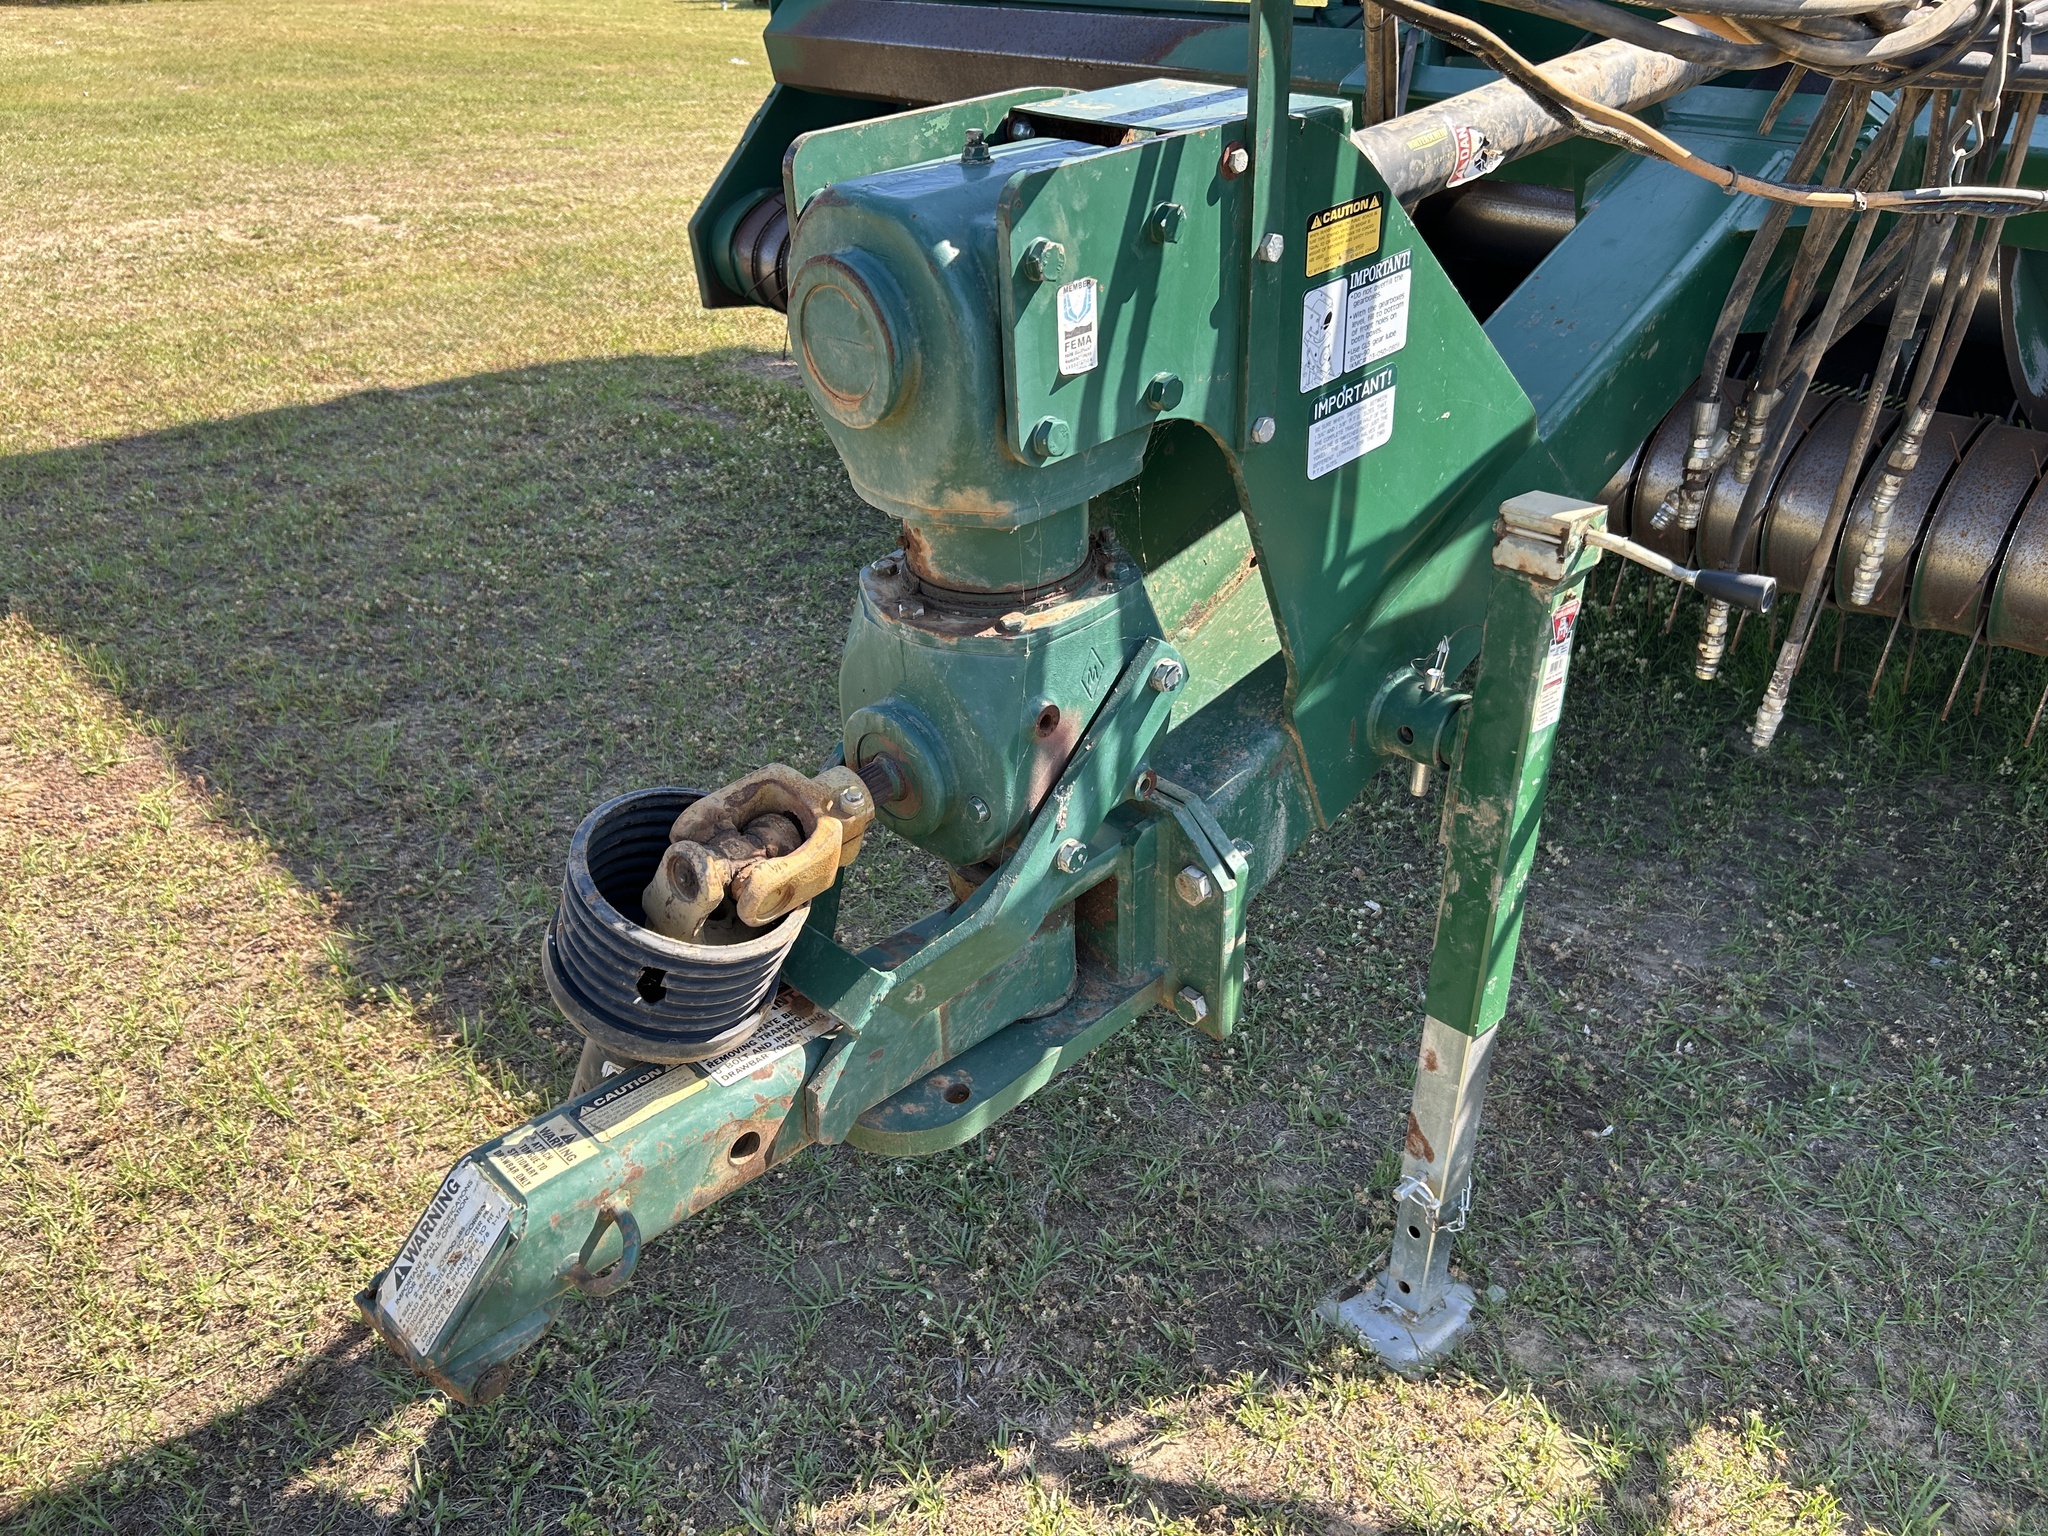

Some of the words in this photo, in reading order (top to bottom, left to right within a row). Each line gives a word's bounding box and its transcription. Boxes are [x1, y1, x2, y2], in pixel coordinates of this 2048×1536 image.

[1323, 199, 1370, 224] CAUTION
[1063, 279, 1091, 294] MEMBER
[1350, 250, 1411, 289] IMPORTANT!
[1353, 290, 1361, 300] Do
[1362, 286, 1371, 296] not
[1064, 334, 1092, 352] FEMA
[1314, 368, 1392, 420] IMPORTANT!
[706, 1038, 757, 1070] REMOVING
[757, 1012, 806, 1042] TRANSPO
[725, 1052, 750, 1069] BOLT
[751, 1040, 772, 1055] AND
[773, 1011, 825, 1044] INSTALLING
[720, 1051, 769, 1082] DRAWBAR
[590, 1067, 663, 1107] CAUTION
[506, 1147, 538, 1178] STATIONARY
[518, 1143, 541, 1164] TONGUE
[536, 1162, 548, 1171] TO
[530, 1140, 554, 1161] ATTACH
[537, 1126, 579, 1162] WARNING
[492, 1149, 519, 1175] DRAWBAR
[515, 1172, 531, 1187] ONLY
[401, 1176, 461, 1266] WARNING
[394, 1260, 423, 1305] IMPORTANT
[422, 1240, 435, 1259] BALL
[434, 1178, 473, 1239] SPECIFICATIONS
[404, 1280, 416, 1298] FOR
[416, 1260, 429, 1279] SAFE
[428, 1240, 441, 1259] BALL
[440, 1195, 469, 1239] OPERATION
[413, 1301, 433, 1333] TORQUE
[432, 1281, 445, 1299] AND
[463, 1219, 482, 1249] COTTER
[417, 1322, 427, 1337] USE
[450, 1255, 467, 1282] SHANK
[478, 1223, 487, 1236] TO
[486, 1212, 494, 1223] FIT
[404, 1301, 419, 1323] LOAD
[409, 1295, 429, 1327] TIGHTEN
[428, 1264, 448, 1295] CASTLE
[425, 1316, 444, 1347] GREASE
[444, 1279, 467, 1315] COUPLER
[420, 1303, 445, 1342] DRAWBAR
